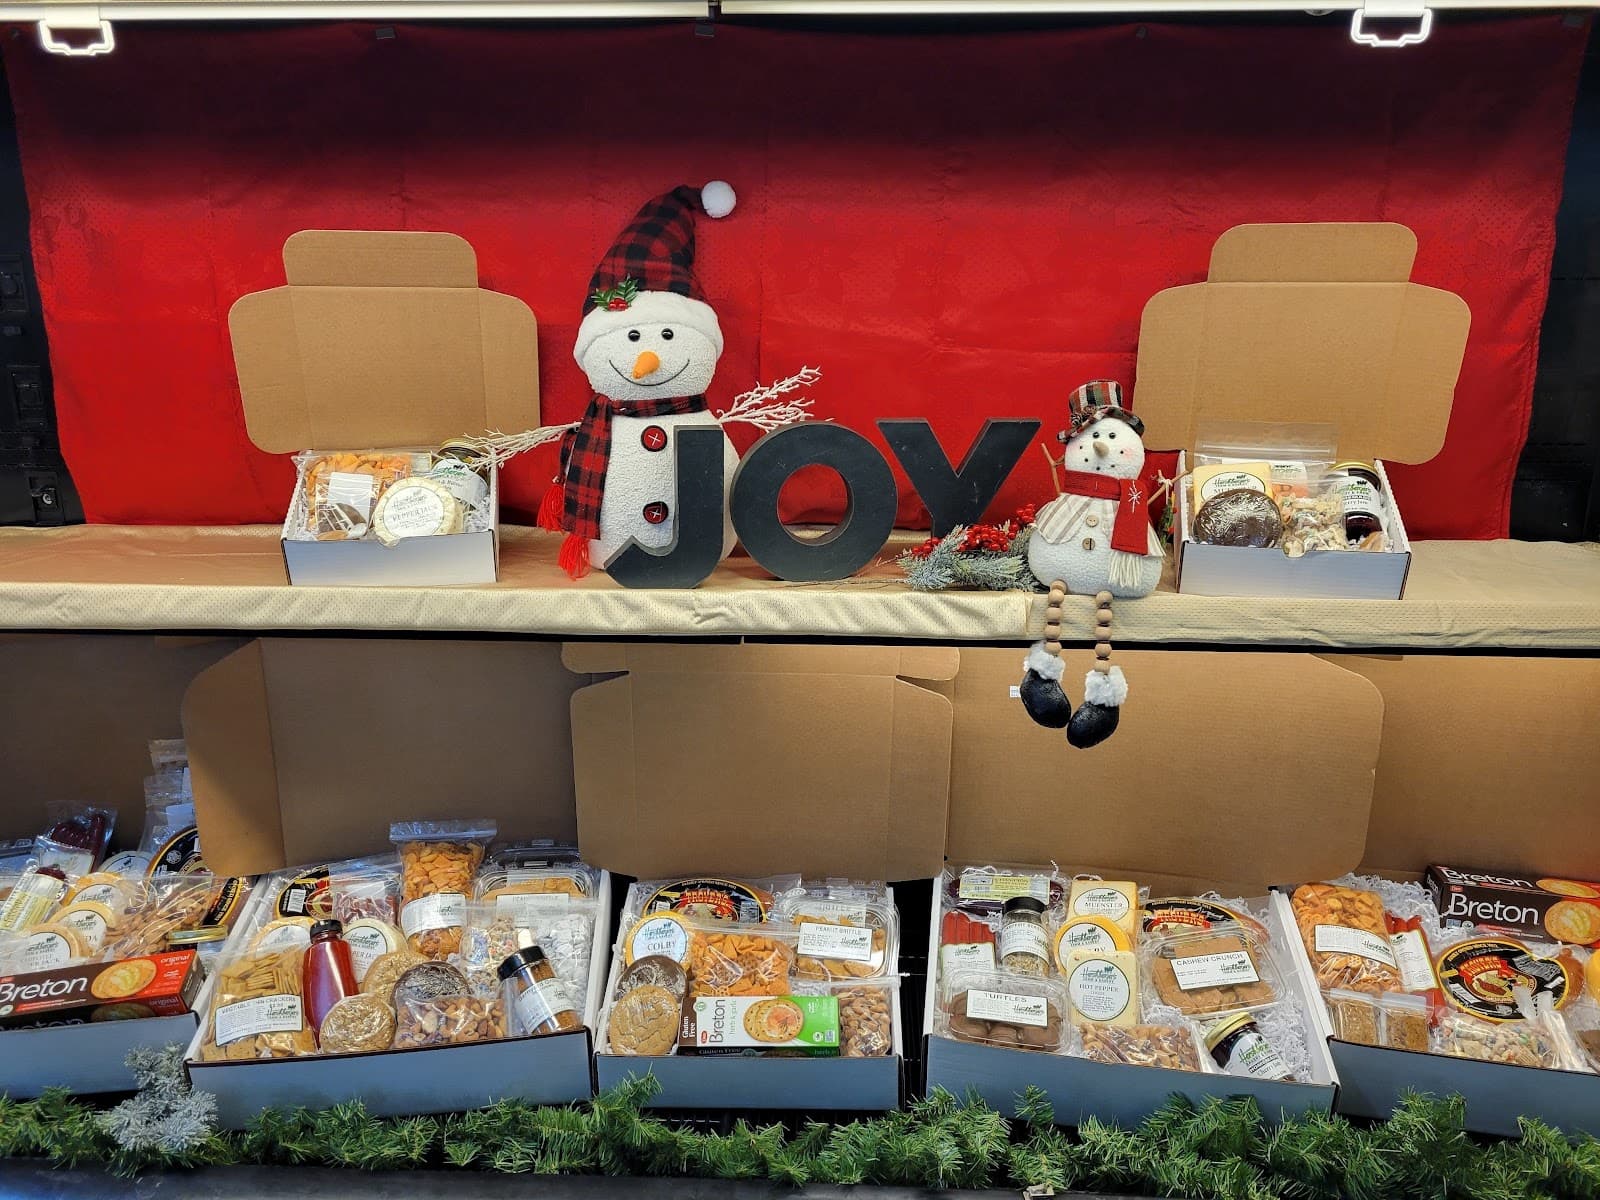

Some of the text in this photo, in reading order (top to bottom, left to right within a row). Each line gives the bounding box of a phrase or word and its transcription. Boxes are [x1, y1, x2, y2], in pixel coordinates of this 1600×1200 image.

[603, 417, 1042, 589] JOY
[1441, 868, 1534, 888] Breton
[1449, 892, 1541, 925] Breton
[647, 940, 676, 951] COLBY
[160, 953, 191, 964] original
[1176, 957, 1209, 966] CASHEW
[0, 976, 88, 1002] Breton
[984, 992, 1028, 1003] TURTLES
[1094, 984, 1119, 993] PEPPER
[681, 1015, 689, 1038] Gluten
[708, 999, 726, 1043] Breton
